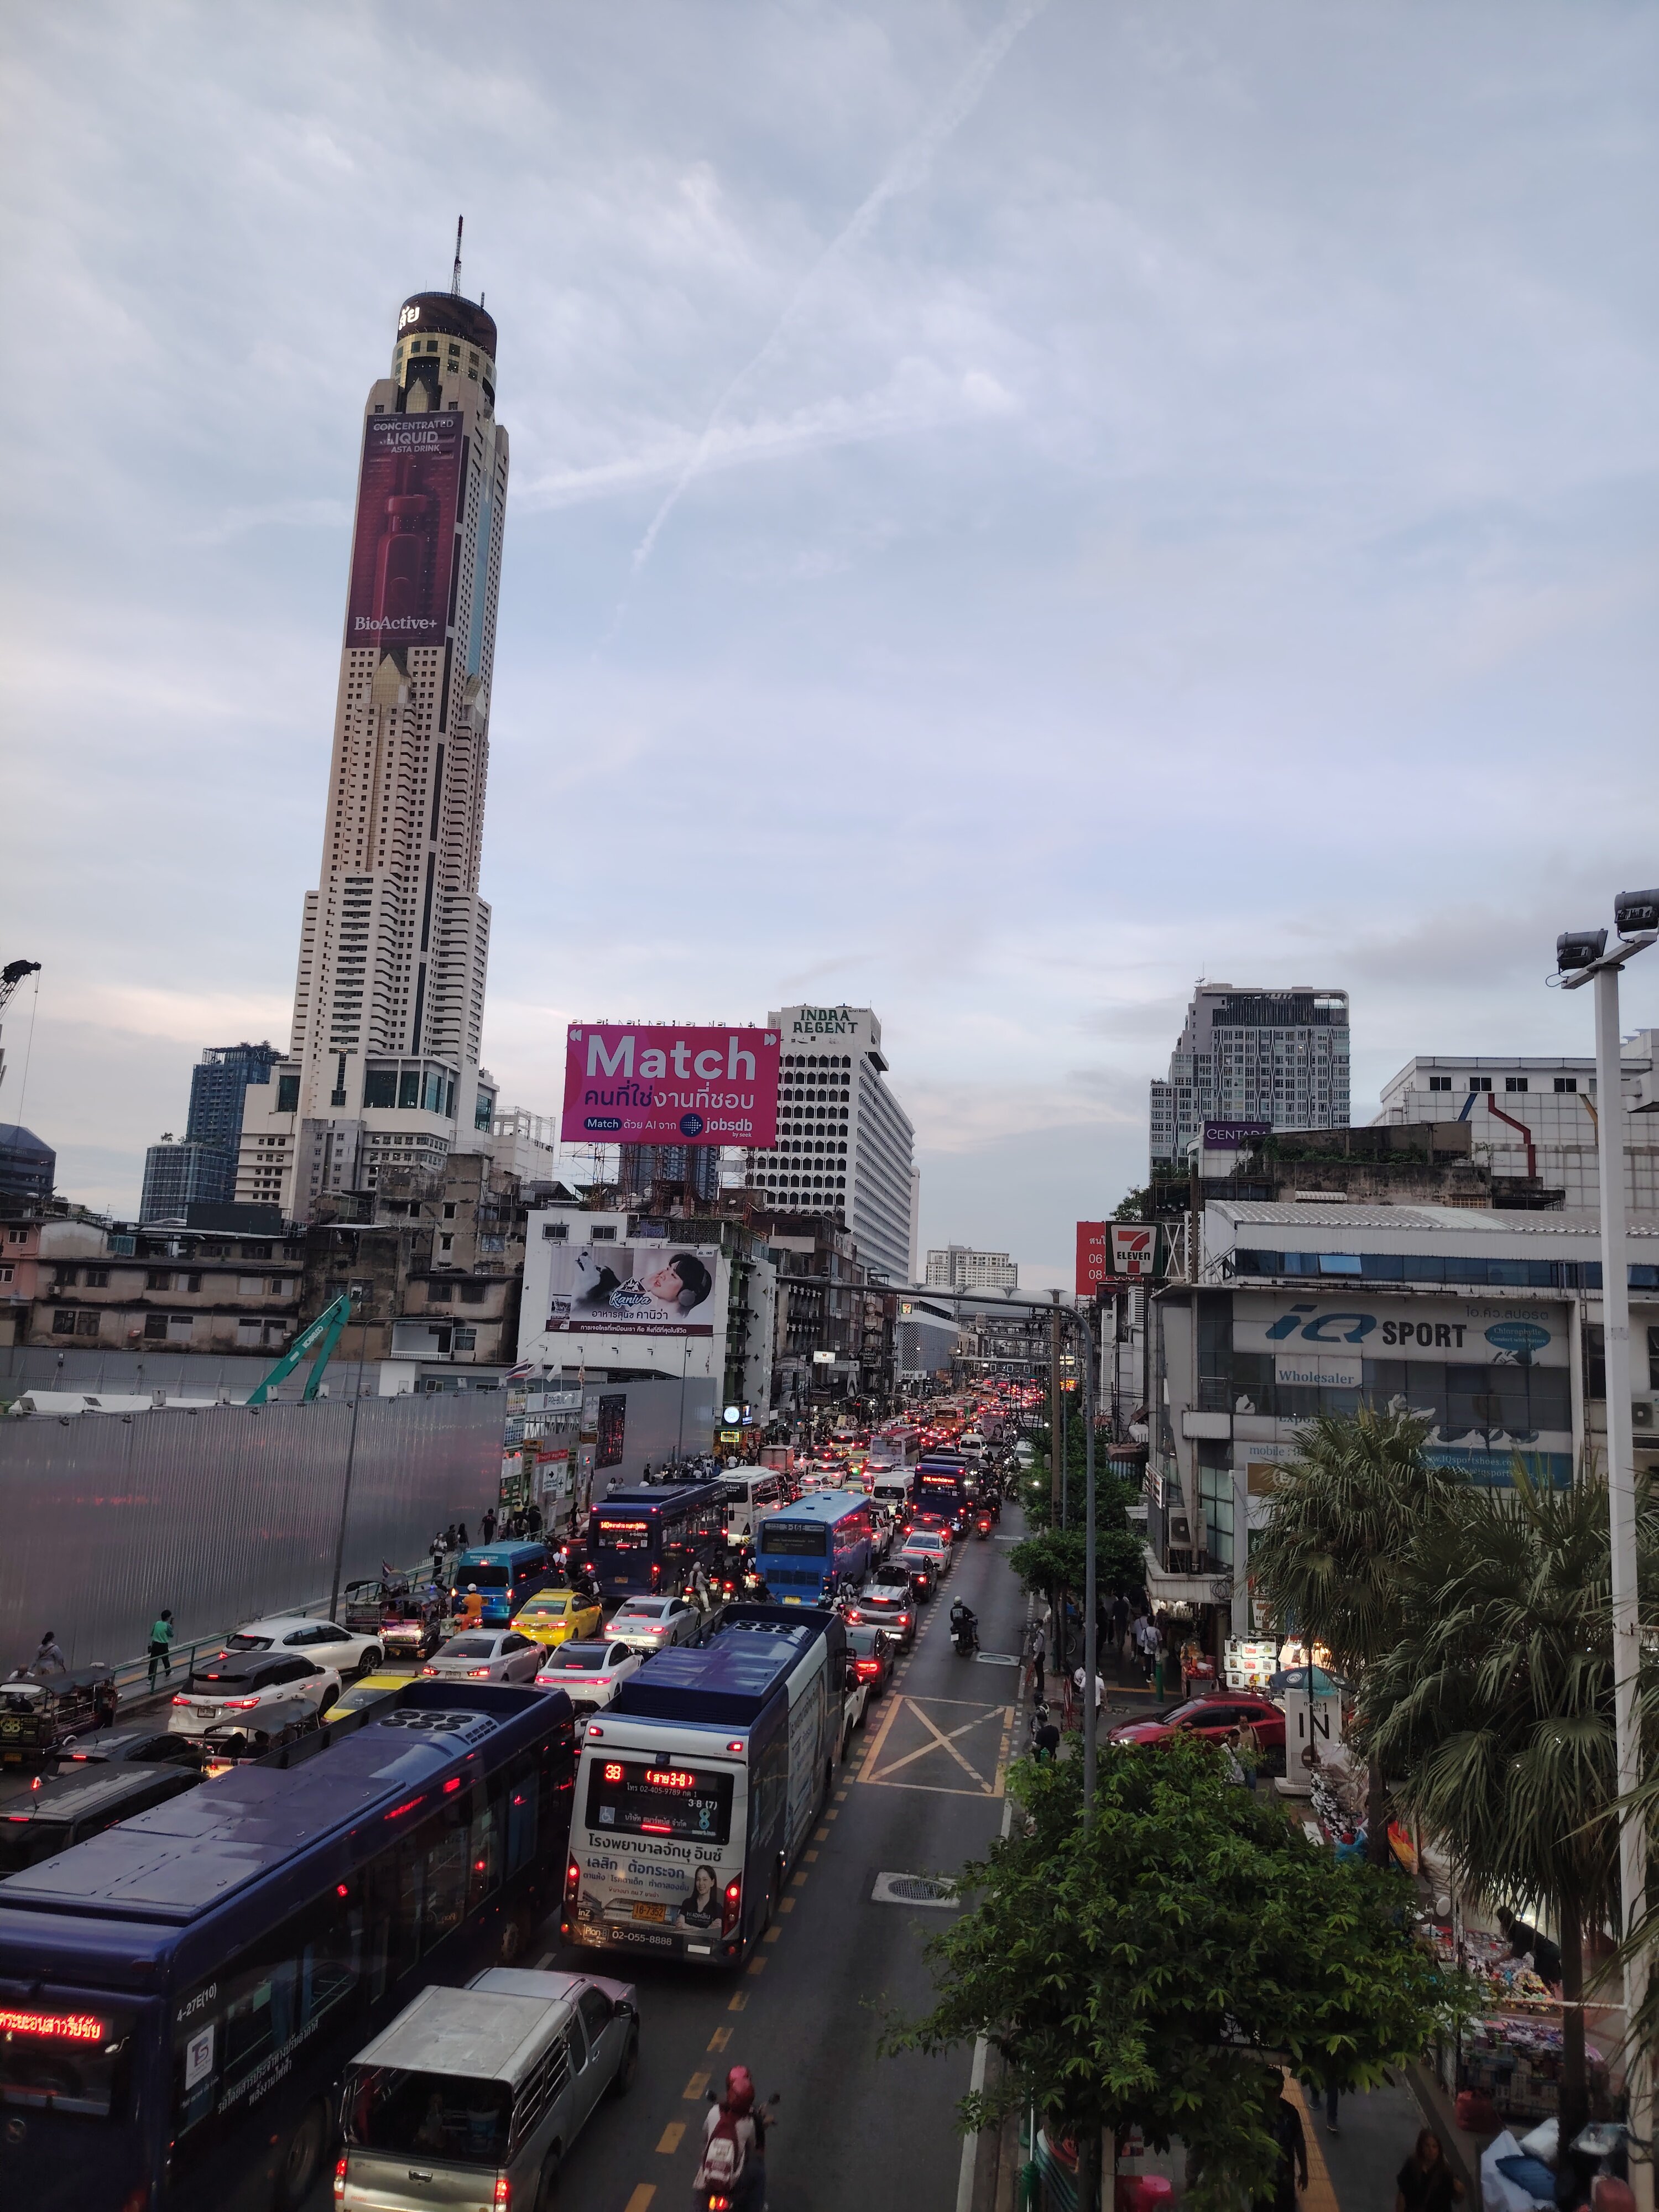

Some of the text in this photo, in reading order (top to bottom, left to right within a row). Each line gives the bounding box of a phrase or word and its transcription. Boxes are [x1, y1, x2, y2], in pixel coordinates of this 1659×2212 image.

[373, 419, 454, 431] CONCENTRATED
[387, 431, 439, 445] LIQUID
[354, 616, 437, 630] BioActive+
[801, 1009, 850, 1021] INDRA
[793, 1021, 858, 1034] REGENT
[586, 1035, 756, 1081] Match
[587, 1119, 619, 1129] Match
[623, 1118, 643, 1130] ด้วย
[645, 1120, 656, 1129] AI
[705, 1118, 753, 1134] jobsdb
[610, 1292, 651, 1308] Kaniva
[592, 1308, 668, 1321] อาหารสุนัข คานิว่า
[302, 1326, 324, 1348] KOBELCO
[1383, 1321, 1467, 1348] SPORT
[1279, 1370, 1354, 1385] Wholesaler
[1250, 1446, 1285, 1456] mobile
[1299, 1713, 1329, 1739] IN
[606, 1764, 621, 1780] 38
[627, 1782, 638, 1792] โทร
[640, 1786, 680, 1796] 02-405-9789
[705, 1799, 718, 1811] (7)
[589, 1833, 691, 1863] โรงพยาบาลจักษุ
[587, 1856, 685, 1879] เลสิก ต้อกระจก
[612, 1931, 672, 1946] 02-055-8888
[176, 1982, 217, 2022] 4-27E(10)
